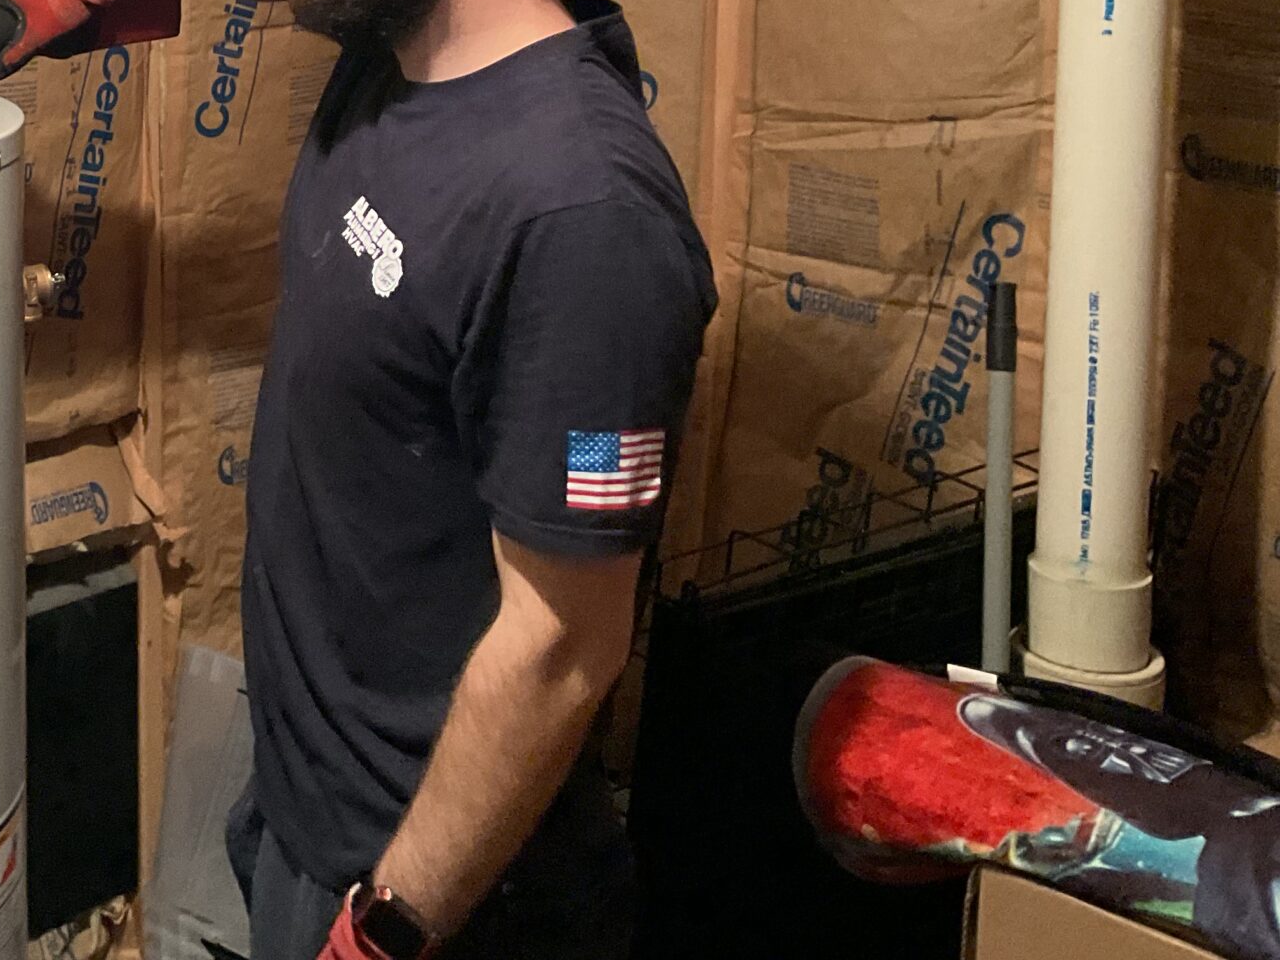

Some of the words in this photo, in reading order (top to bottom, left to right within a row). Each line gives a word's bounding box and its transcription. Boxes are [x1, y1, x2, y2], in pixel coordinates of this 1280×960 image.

[57, 44, 130, 320] CertainTeed
[341, 226, 365, 257] HVAC
[31, 481, 109, 525] GREENGUARD
